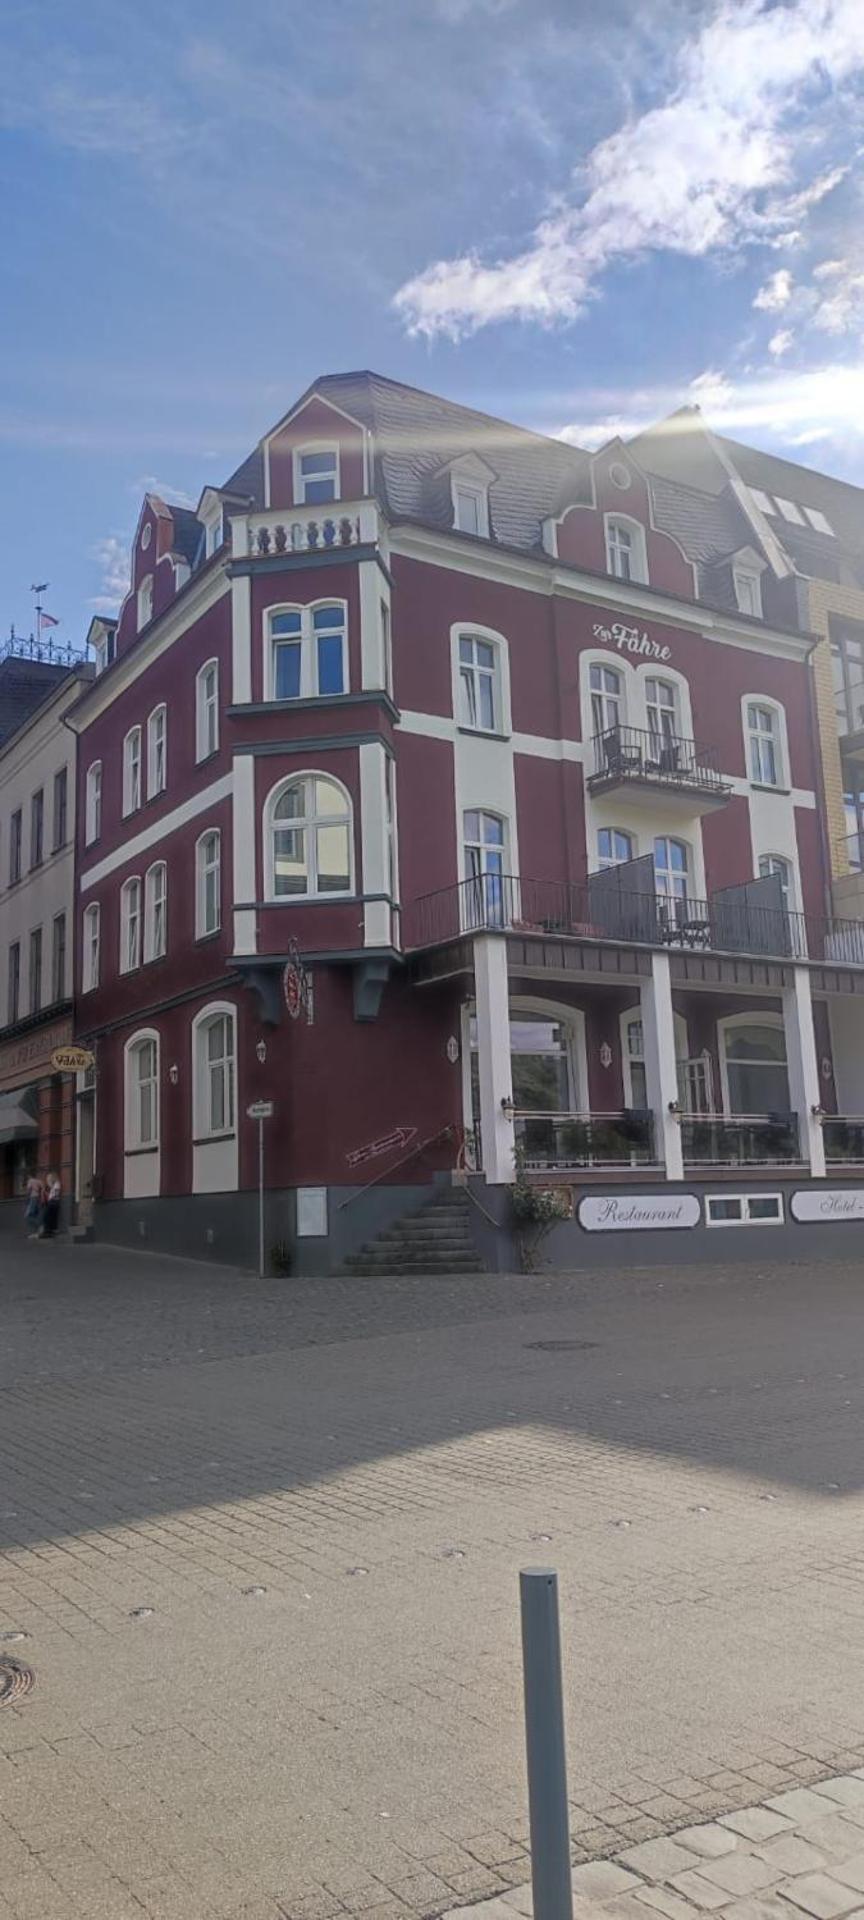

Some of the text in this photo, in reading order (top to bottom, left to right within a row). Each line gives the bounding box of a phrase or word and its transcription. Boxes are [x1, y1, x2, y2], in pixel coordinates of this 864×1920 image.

[611, 623, 671, 660] Fähre
[597, 1199, 682, 1222] Restaurant
[820, 1194, 857, 1213] Hotel
